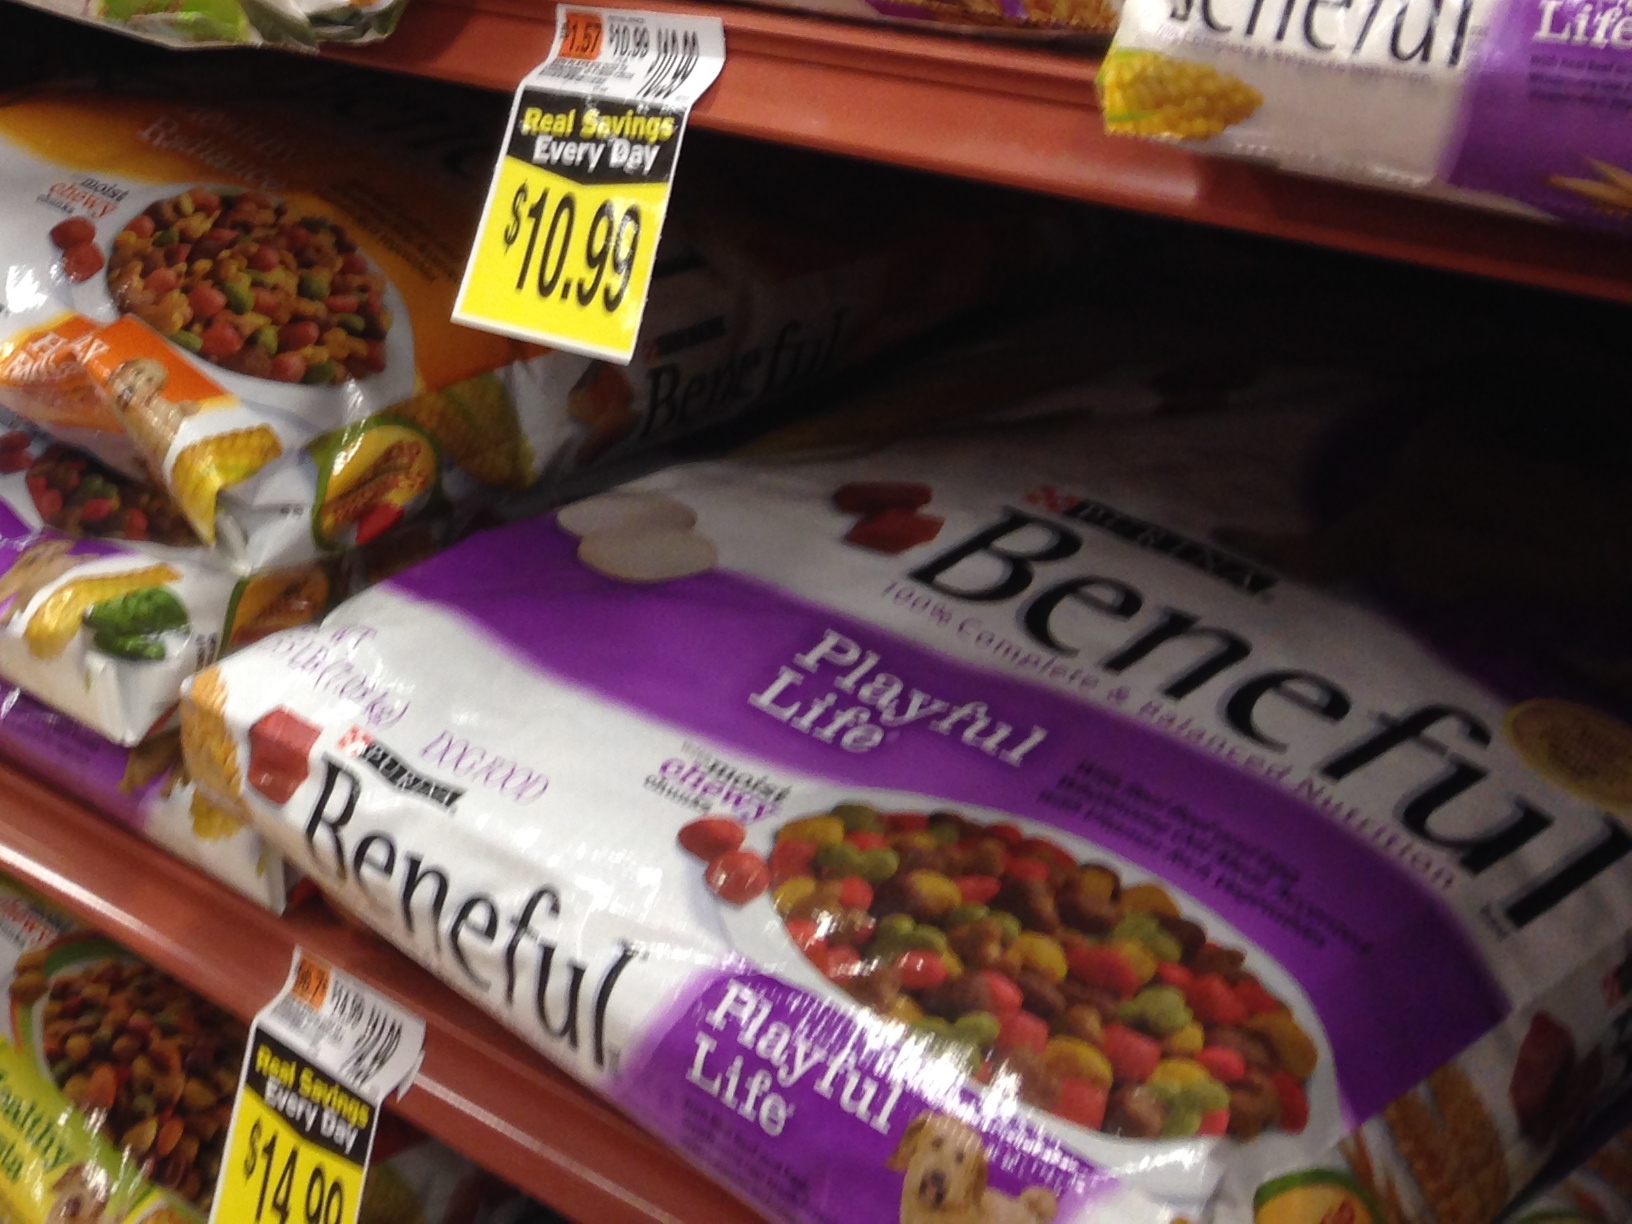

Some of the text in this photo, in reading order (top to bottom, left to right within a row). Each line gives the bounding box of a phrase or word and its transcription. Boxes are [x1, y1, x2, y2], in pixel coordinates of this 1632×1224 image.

[522, 107, 677, 142] Real Savings
[532, 137, 661, 175] Every Day
[48, 181, 116, 219] chewy
[81, 176, 130, 202] moist
[503, 178, 644, 314] $10.99
[746, 664, 884, 753] Life
[792, 627, 1049, 768] Playful
[881, 579, 954, 628] 100%
[957, 612, 1100, 698] Complete
[1107, 683, 1132, 707] &
[1140, 696, 1292, 787] Balanced
[1294, 777, 1456, 891] Nutrition
[907, 505, 1632, 929] Beneful
[658, 757, 784, 826] chewy
[302, 753, 637, 1068] Beneful
[255, 1044, 370, 1130] Real Savings
[684, 1031, 790, 1137] Life
[706, 978, 905, 1135] Playful
[265, 1076, 359, 1155] Every Day
[244, 1117, 344, 1224] $149
